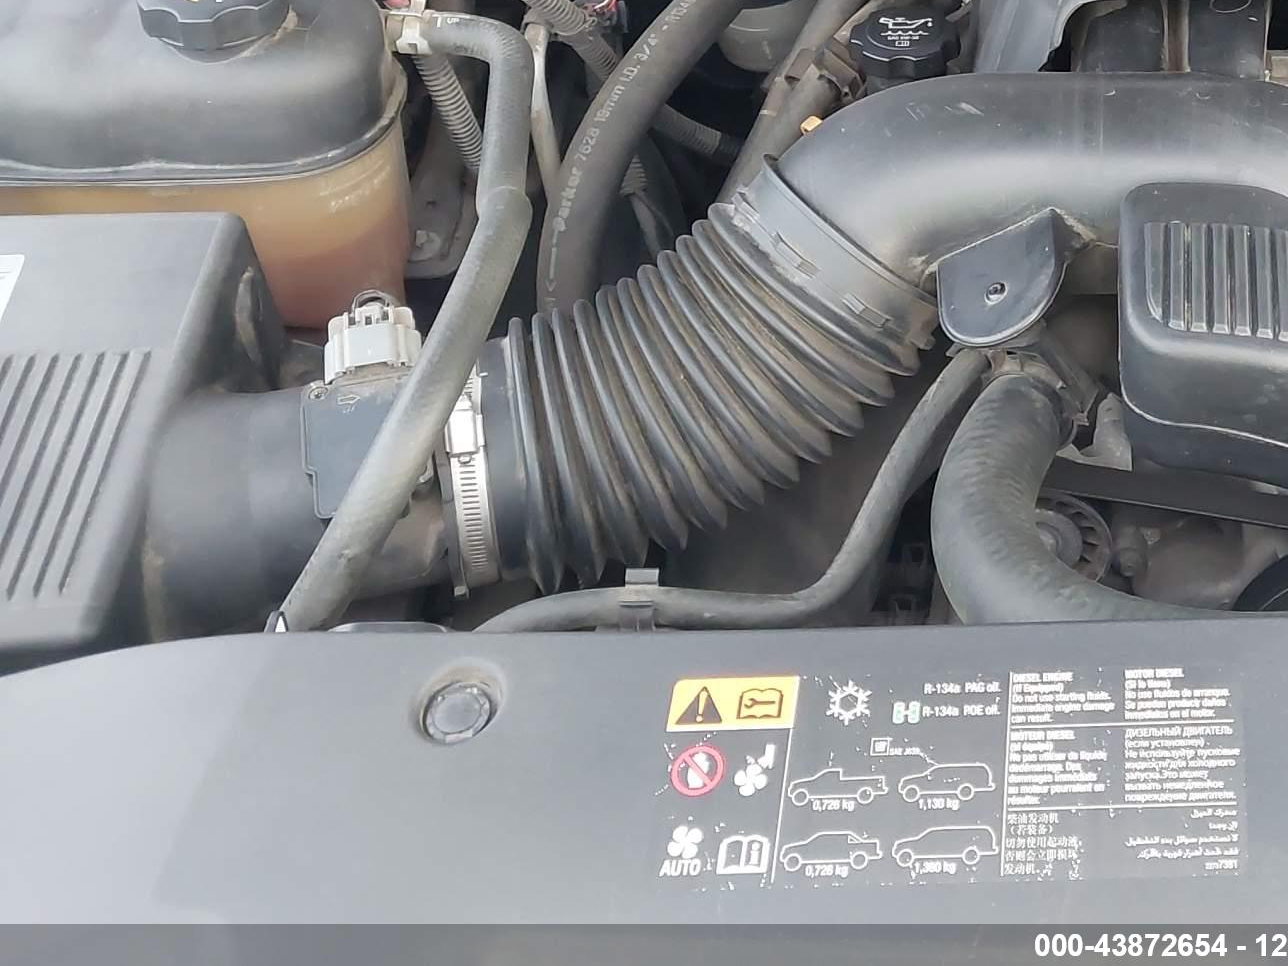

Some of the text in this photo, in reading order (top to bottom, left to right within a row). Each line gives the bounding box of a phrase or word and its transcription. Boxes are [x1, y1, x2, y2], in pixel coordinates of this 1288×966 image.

[1013, 672, 1073, 682] DIESEL ENGINE
[924, 682, 961, 694] R-134a
[965, 682, 985, 692] PAG
[1012, 694, 1023, 702] Do
[1024, 694, 1038, 702] not
[1039, 694, 1054, 702] use
[1055, 692, 1086, 702] starting
[1125, 690, 1136, 699] No
[922, 706, 959, 717] R-134a
[964, 705, 984, 716] POE
[1012, 702, 1115, 713] Immediate engine damage
[1011, 714, 1026, 723] can
[1125, 726, 1232, 738] ДИЗЕЛЬНЫЙ ДВИГАТЕЛЬ
[1022, 754, 1038, 763] pas
[842, 800, 855, 812] kg
[946, 798, 960, 810] kg
[1008, 812, 1059, 825] 柴油发动机
[659, 860, 701, 876] AUTO
[835, 865, 849, 877] kg
[943, 862, 956, 874] kg
